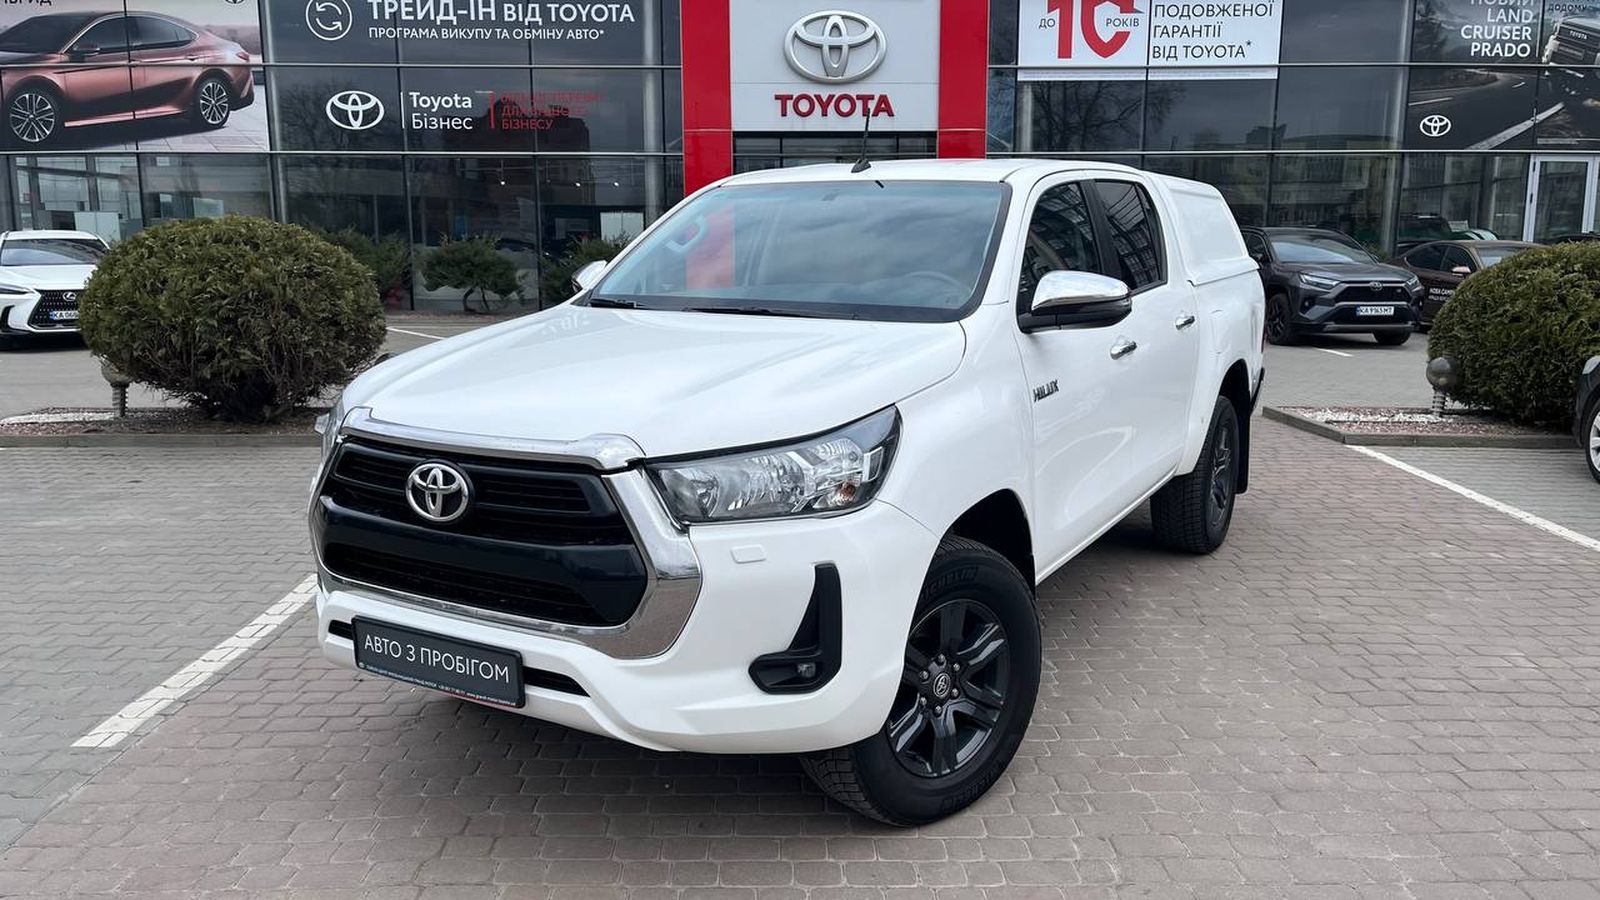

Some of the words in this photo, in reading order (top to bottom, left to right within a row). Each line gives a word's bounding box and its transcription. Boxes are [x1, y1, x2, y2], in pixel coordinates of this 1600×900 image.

[503, 3, 543, 25] ВІД
[546, 3, 636, 22] TOYOTA
[1153, 0, 1274, 20] ПОДОВЖЕНОЇ
[1486, 8, 1533, 23] LAND
[1038, 18, 1056, 30] ДО
[1105, 18, 1140, 28] РОКІВ
[1152, 21, 1223, 39] ГАРАНТІЇ
[1460, 24, 1532, 41] CRUISER
[369, 27, 438, 39] ПРОГРАМА
[441, 28, 493, 39] ВИКУПУ
[494, 28, 511, 39] ТА
[512, 28, 564, 39] ОБМІНУ
[1152, 45, 1179, 61] ВІД
[1470, 43, 1531, 57] PRADO
[409, 91, 473, 112] Toyota
[774, 94, 895, 117] TOYOTA
[411, 113, 473, 130] Бізнес
[501, 118, 554, 130] БІЗНЕСУ
[1032, 379, 1059, 403] HILUX
[364, 634, 402, 660] АВТО
[420, 647, 510, 684] ПРОБІГОМ
